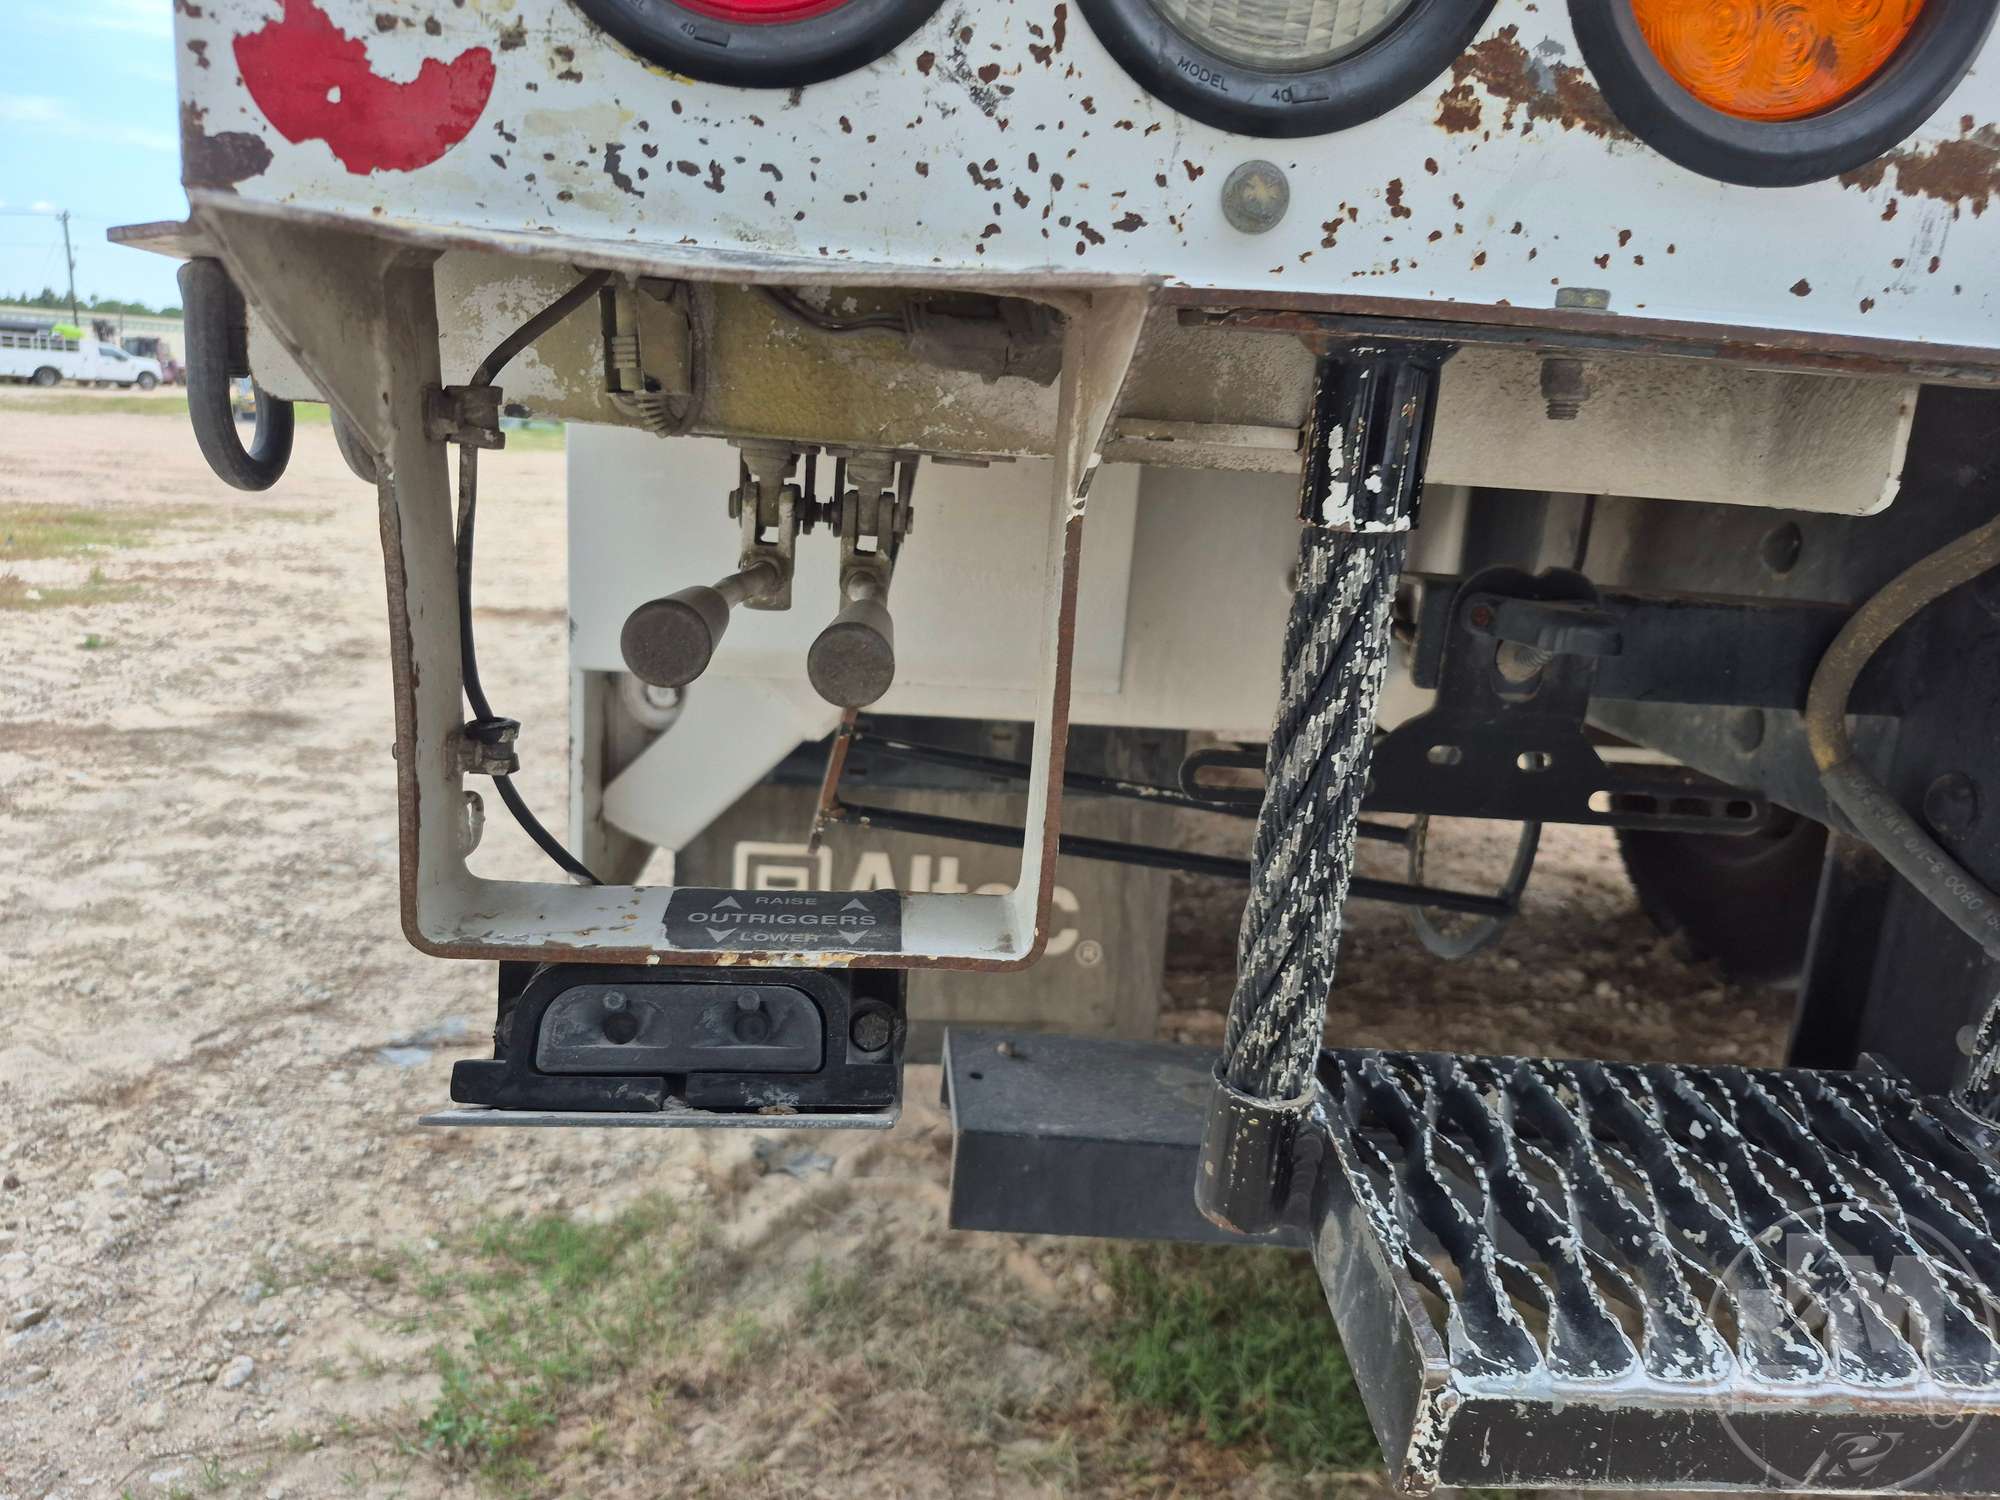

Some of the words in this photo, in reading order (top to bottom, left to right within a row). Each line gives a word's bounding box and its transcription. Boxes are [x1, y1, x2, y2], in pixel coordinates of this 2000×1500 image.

[679, 22, 697, 37] 40
[1176, 55, 1229, 92] MODEL
[1271, 87, 1293, 104] 40
[754, 896, 818, 906] RAISE
[687, 912, 877, 926] OUTRIGGERS
[739, 932, 819, 944] LOWER
